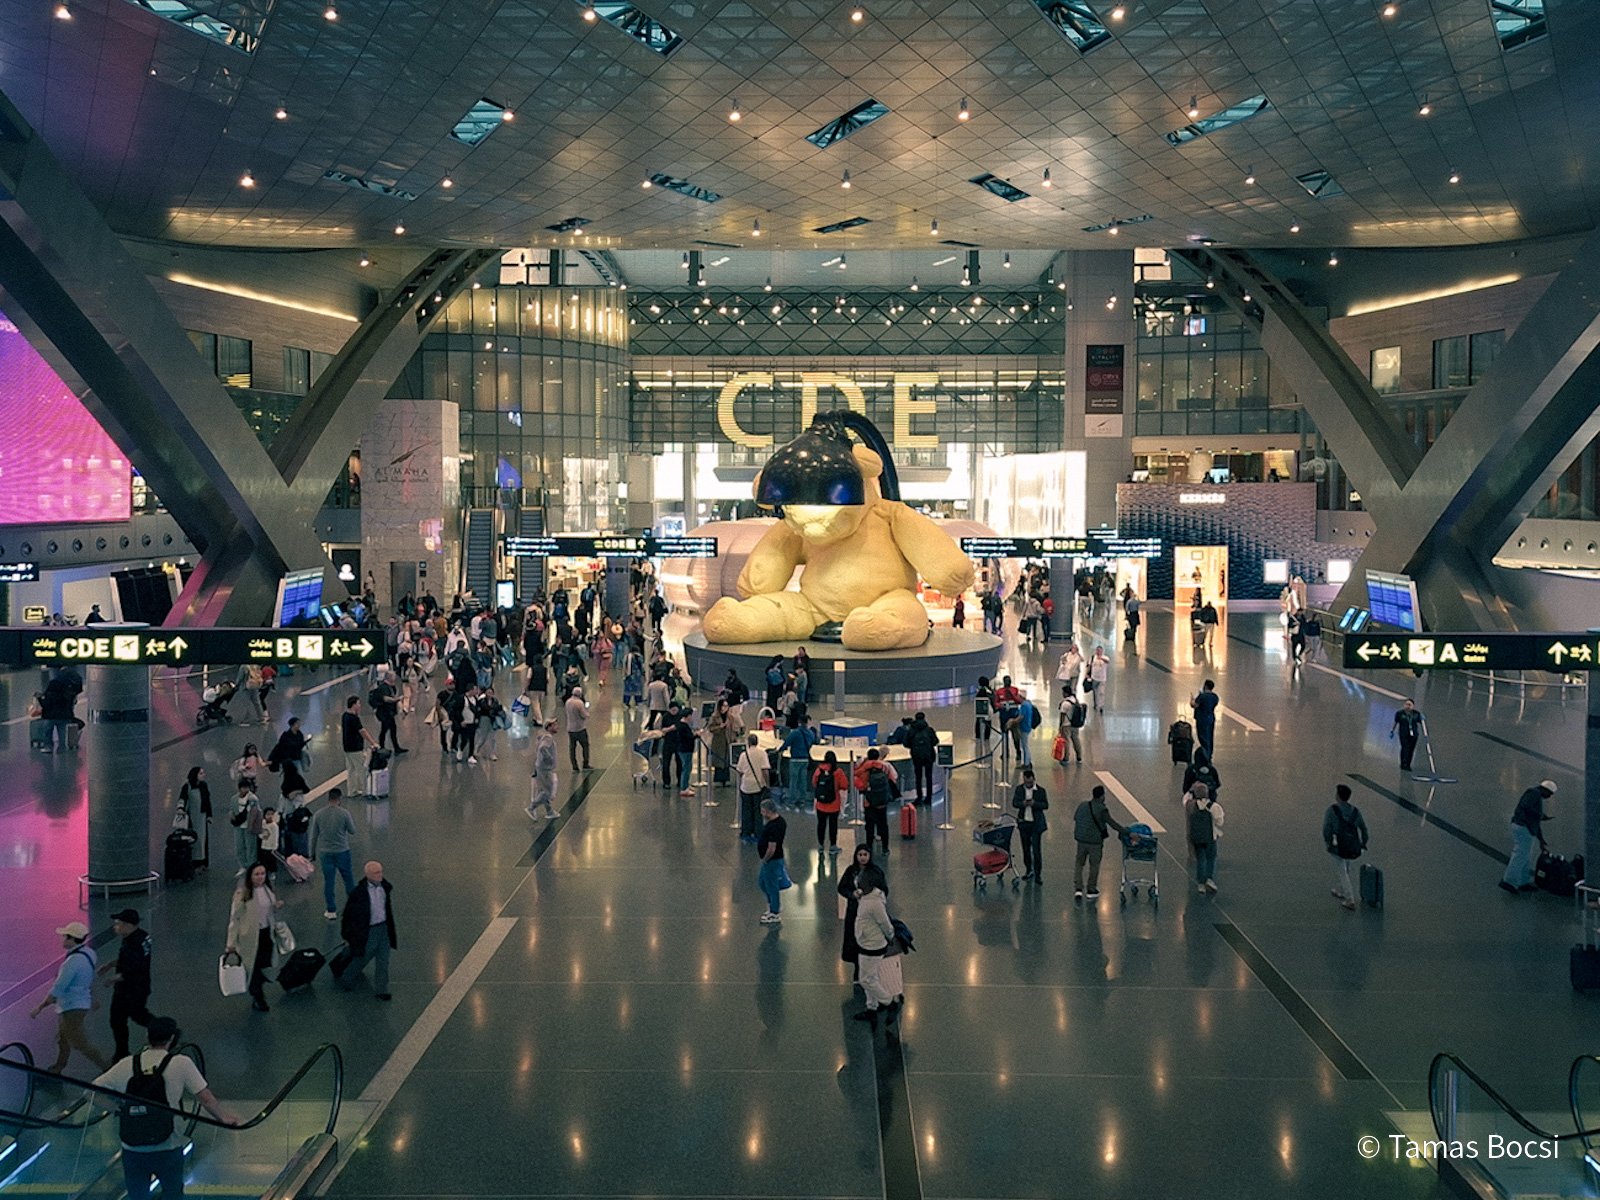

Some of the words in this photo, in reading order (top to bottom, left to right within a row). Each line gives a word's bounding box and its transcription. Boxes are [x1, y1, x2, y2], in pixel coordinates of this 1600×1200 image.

[60, 637, 110, 658] CDE
[276, 638, 293, 658] B
[1439, 642, 1459, 662] A
